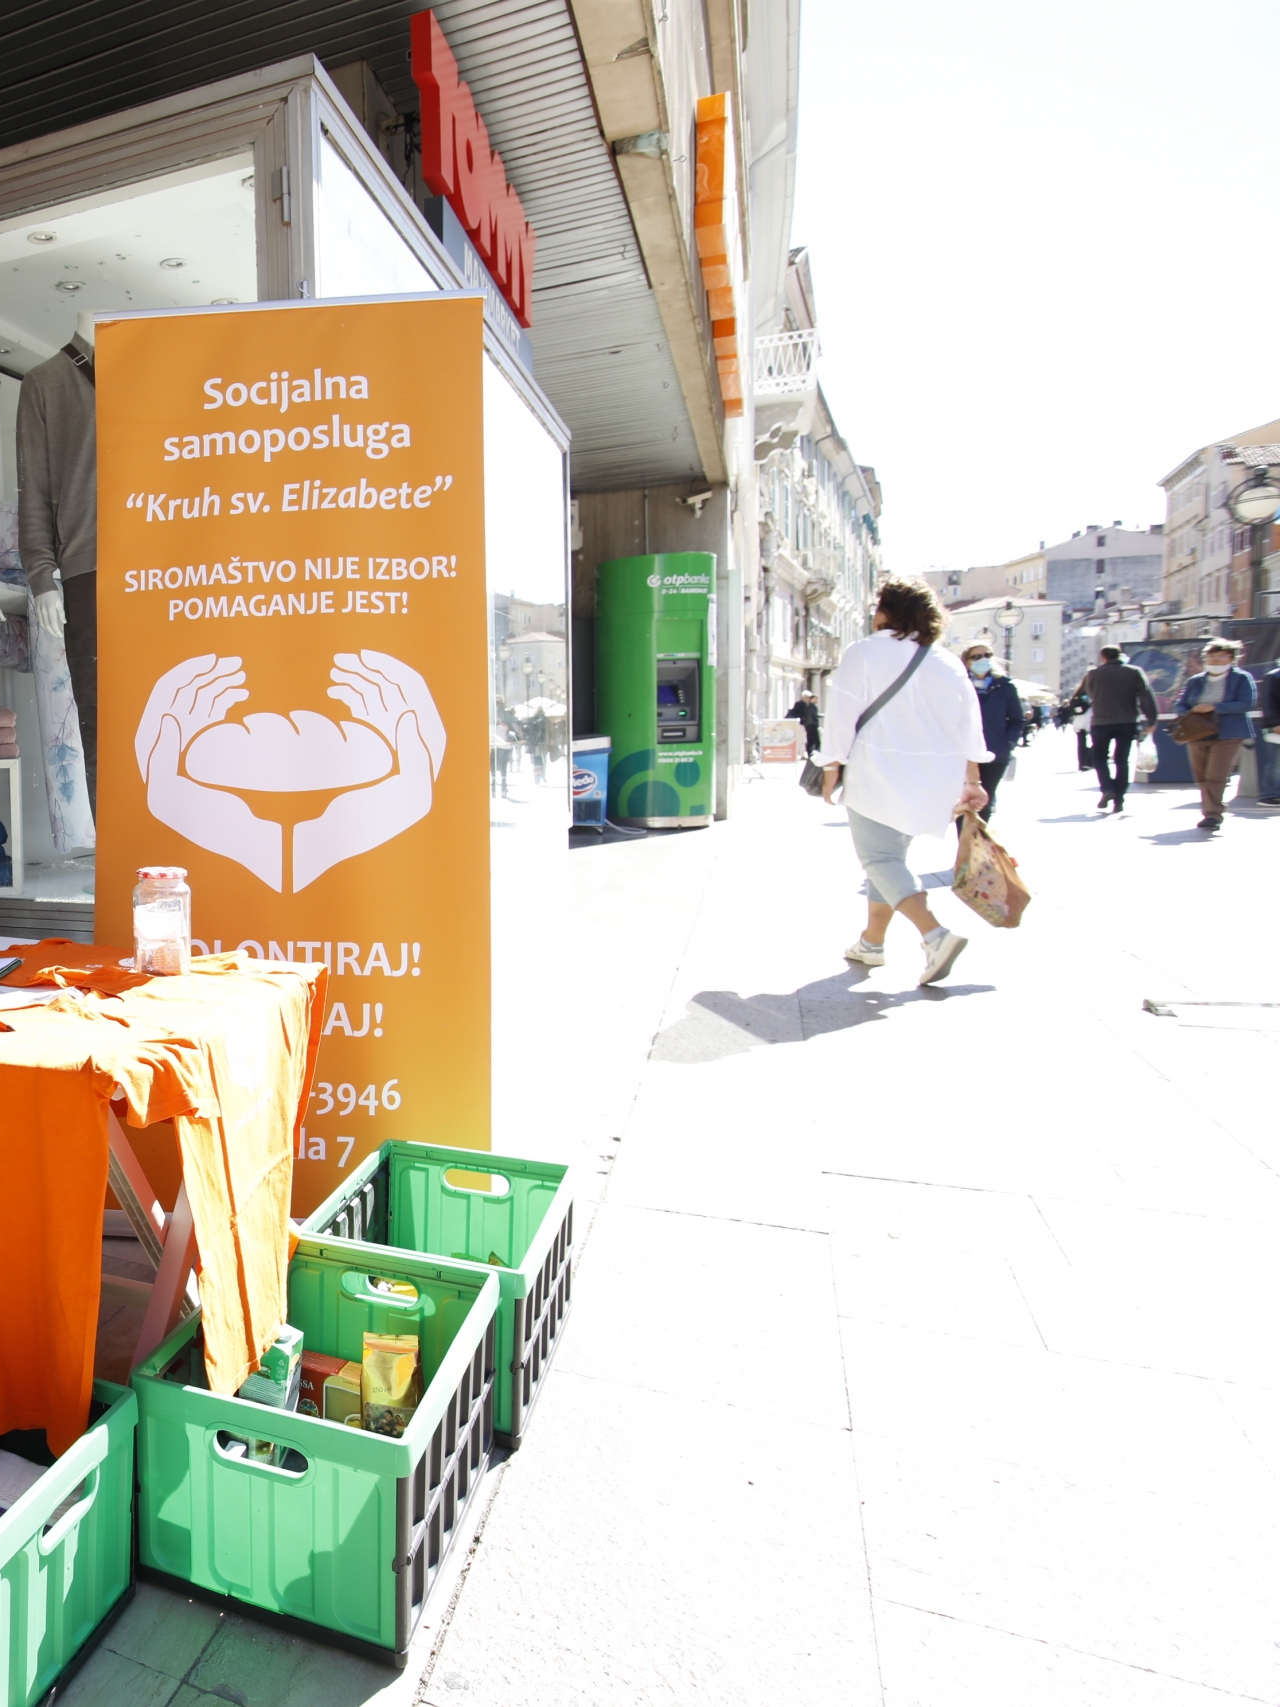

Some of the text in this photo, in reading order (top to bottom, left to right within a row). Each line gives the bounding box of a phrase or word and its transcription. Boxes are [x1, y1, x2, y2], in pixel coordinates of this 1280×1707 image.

[410, 8, 537, 328] TOMMY
[203, 368, 369, 413] Socijalna
[163, 414, 412, 462] samoposluga
[229, 491, 271, 515] sv.
[124, 555, 457, 592] SIROMAŠTVO NIJE IZBOR!
[663, 573, 710, 586] otpbanka
[169, 591, 409, 621] POMAGANJE JEST!
[189, 938, 421, 977] ONTIRAJ!
[321, 1003, 384, 1037] AJ!
[336, 1136, 355, 1168] 7
